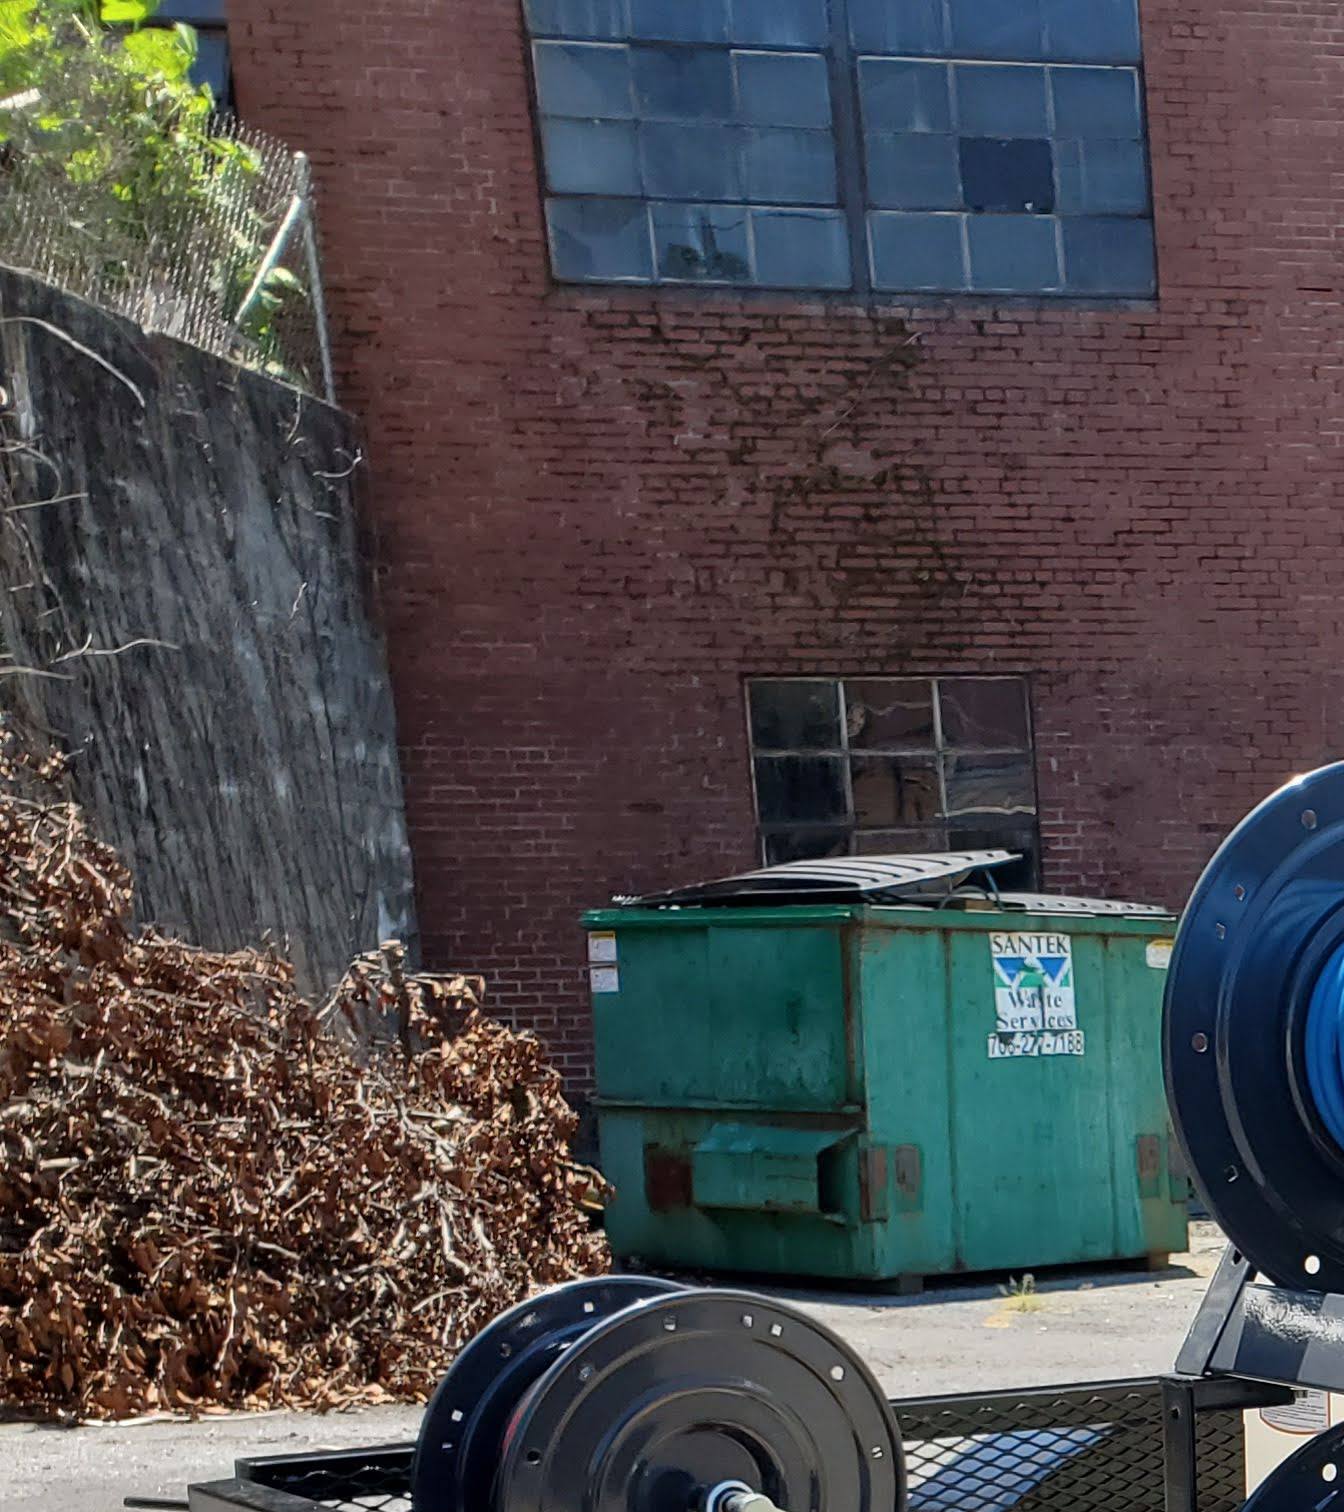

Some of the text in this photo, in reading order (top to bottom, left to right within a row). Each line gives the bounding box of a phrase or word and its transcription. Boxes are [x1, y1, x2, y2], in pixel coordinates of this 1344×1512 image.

[992, 935, 1069, 954] SANTEK
[997, 1013, 1074, 1029] Servces
[989, 1033, 1082, 1056] 70-27-7188
